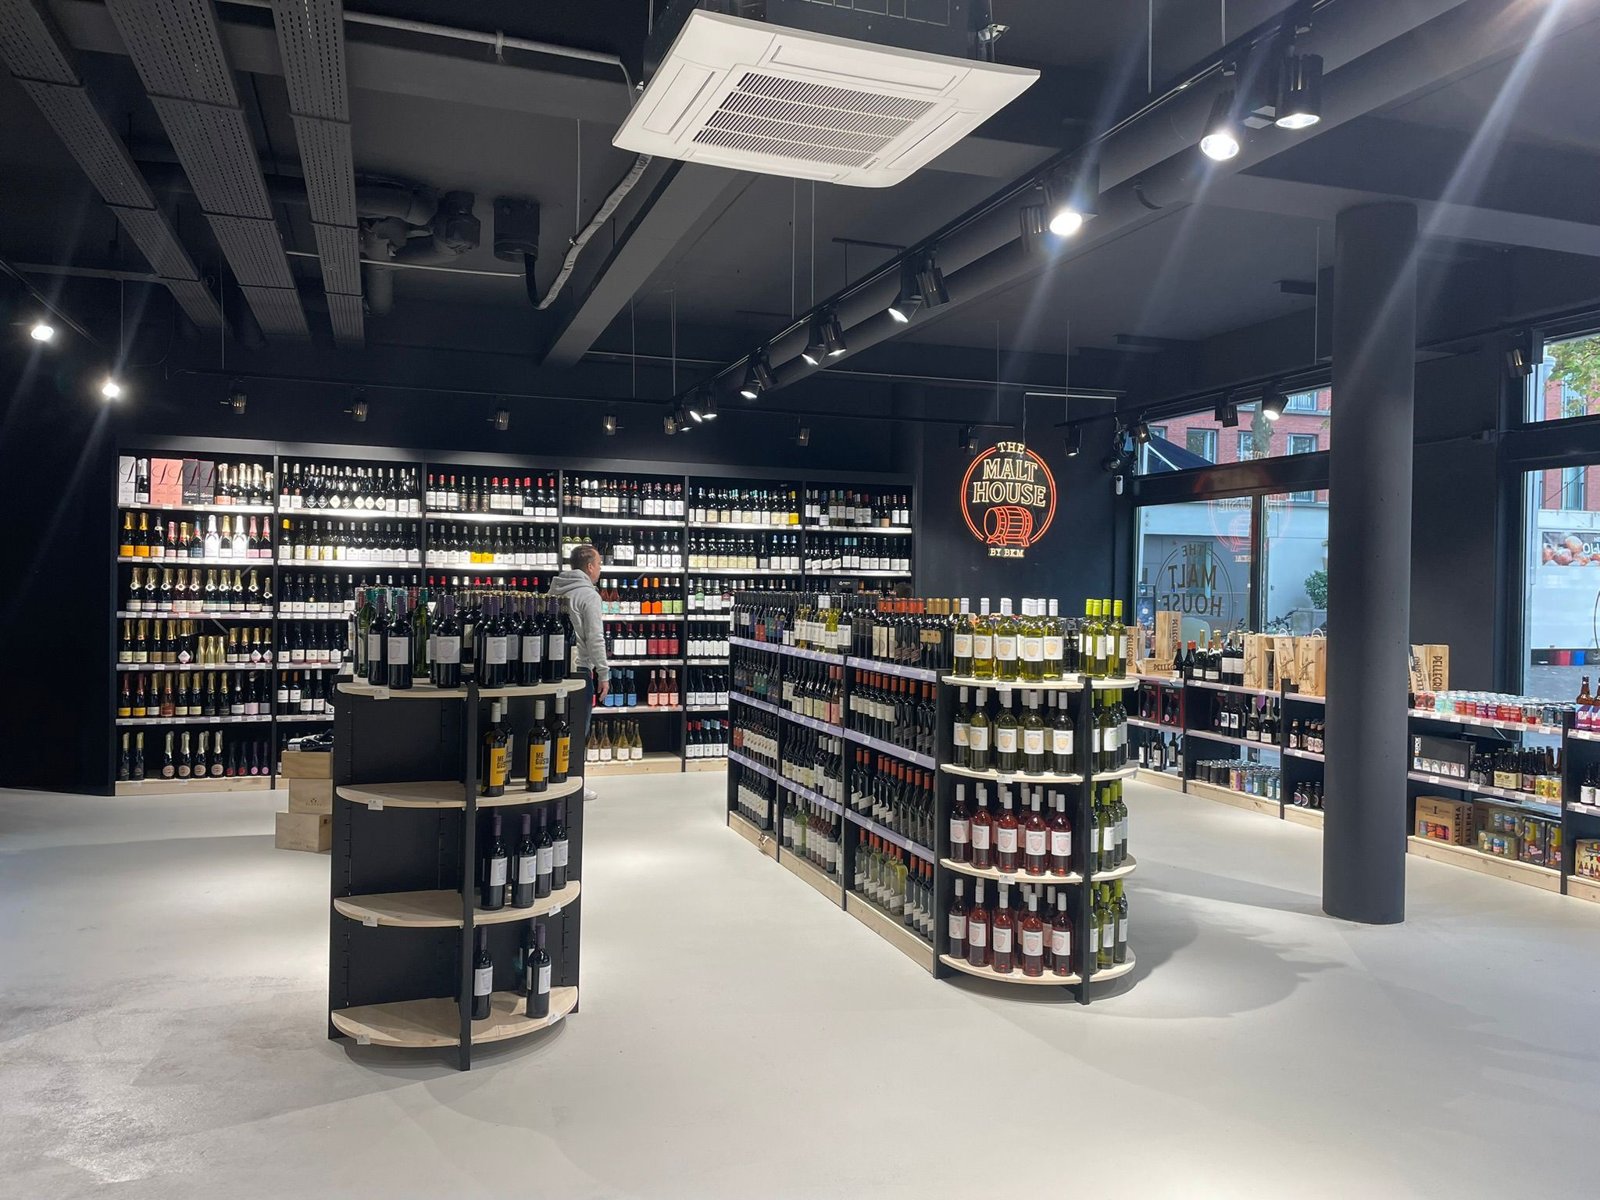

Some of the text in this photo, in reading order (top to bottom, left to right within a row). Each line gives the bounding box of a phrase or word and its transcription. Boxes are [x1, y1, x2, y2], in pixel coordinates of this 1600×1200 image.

[997, 441, 1026, 454] THE
[982, 458, 1038, 482] MALT
[972, 481, 1047, 507] HOUSE
[989, 547, 1025, 558] BY BKM
